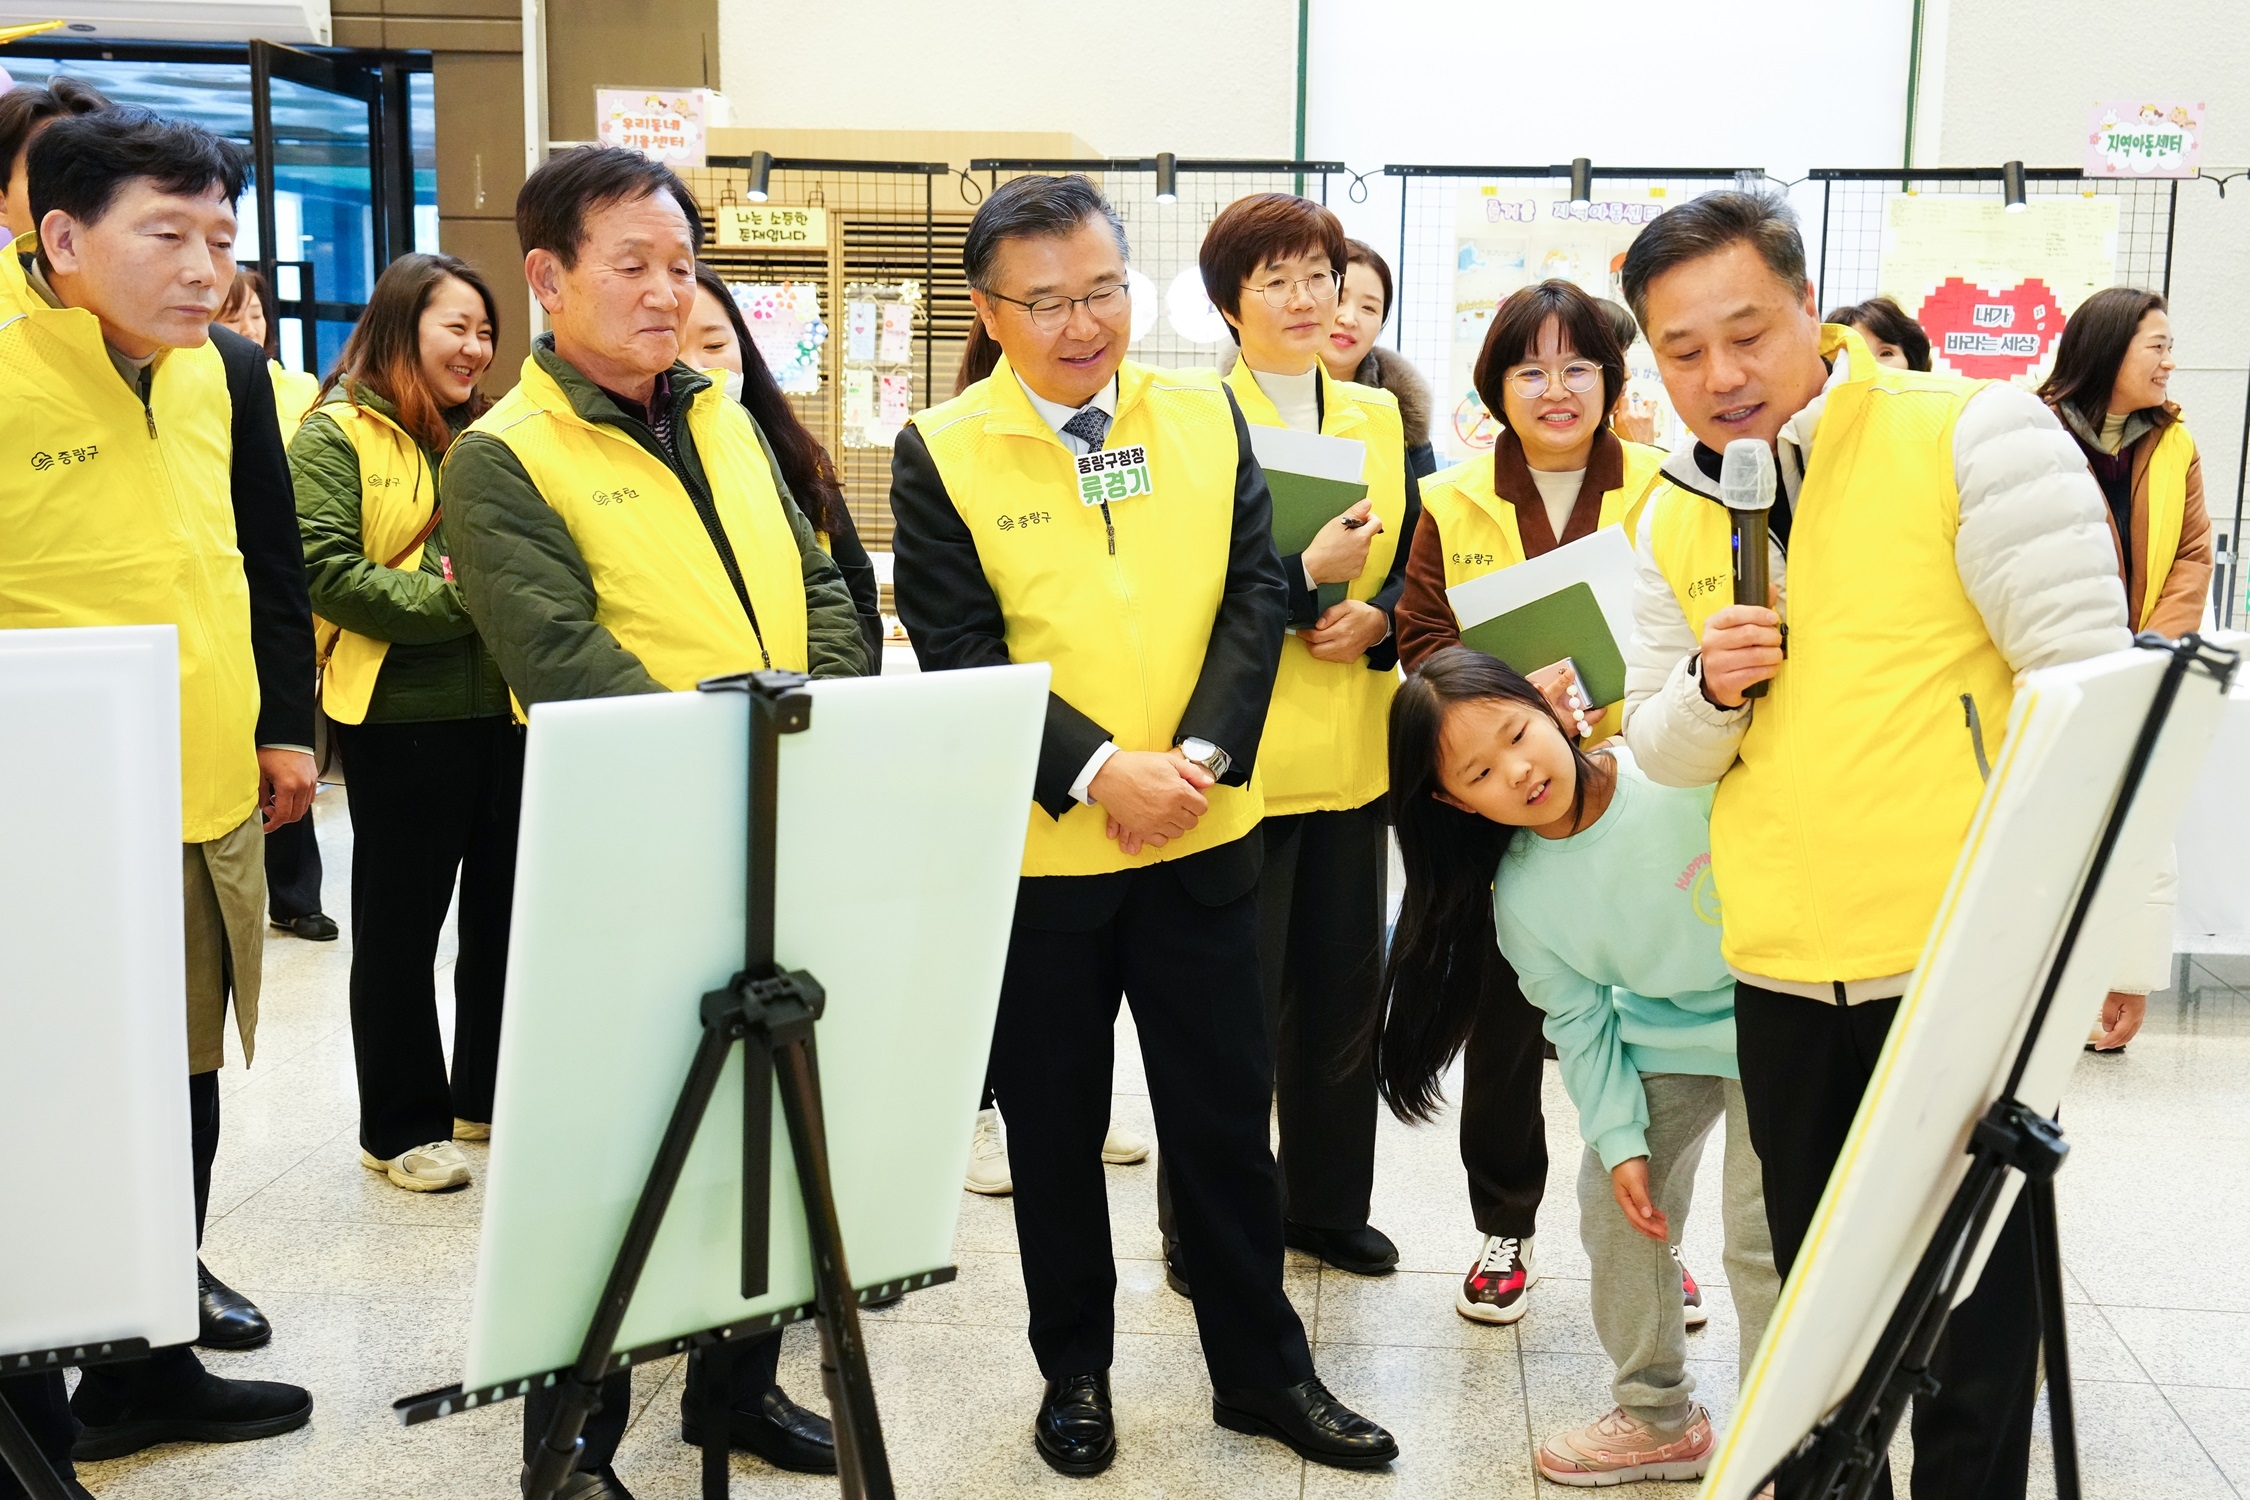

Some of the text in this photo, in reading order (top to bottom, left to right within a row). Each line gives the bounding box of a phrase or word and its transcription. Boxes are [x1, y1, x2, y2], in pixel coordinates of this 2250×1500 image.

[623, 117, 681, 132] 우리동네
[623, 134, 685, 149] 키움센터
[2107, 133, 2183, 157] 지역아동센터
[736, 211, 763, 226] 나는
[1975, 307, 2011, 323] 내가
[1947, 335, 2036, 352] 바라는 세상
[57, 445, 99, 465] 중랑구
[1077, 447, 1145, 475] 중랑구청장
[1081, 465, 1150, 504] 류경기
[1017, 511, 1052, 529] 중랑구
[1463, 553, 1494, 566] 중랑구
